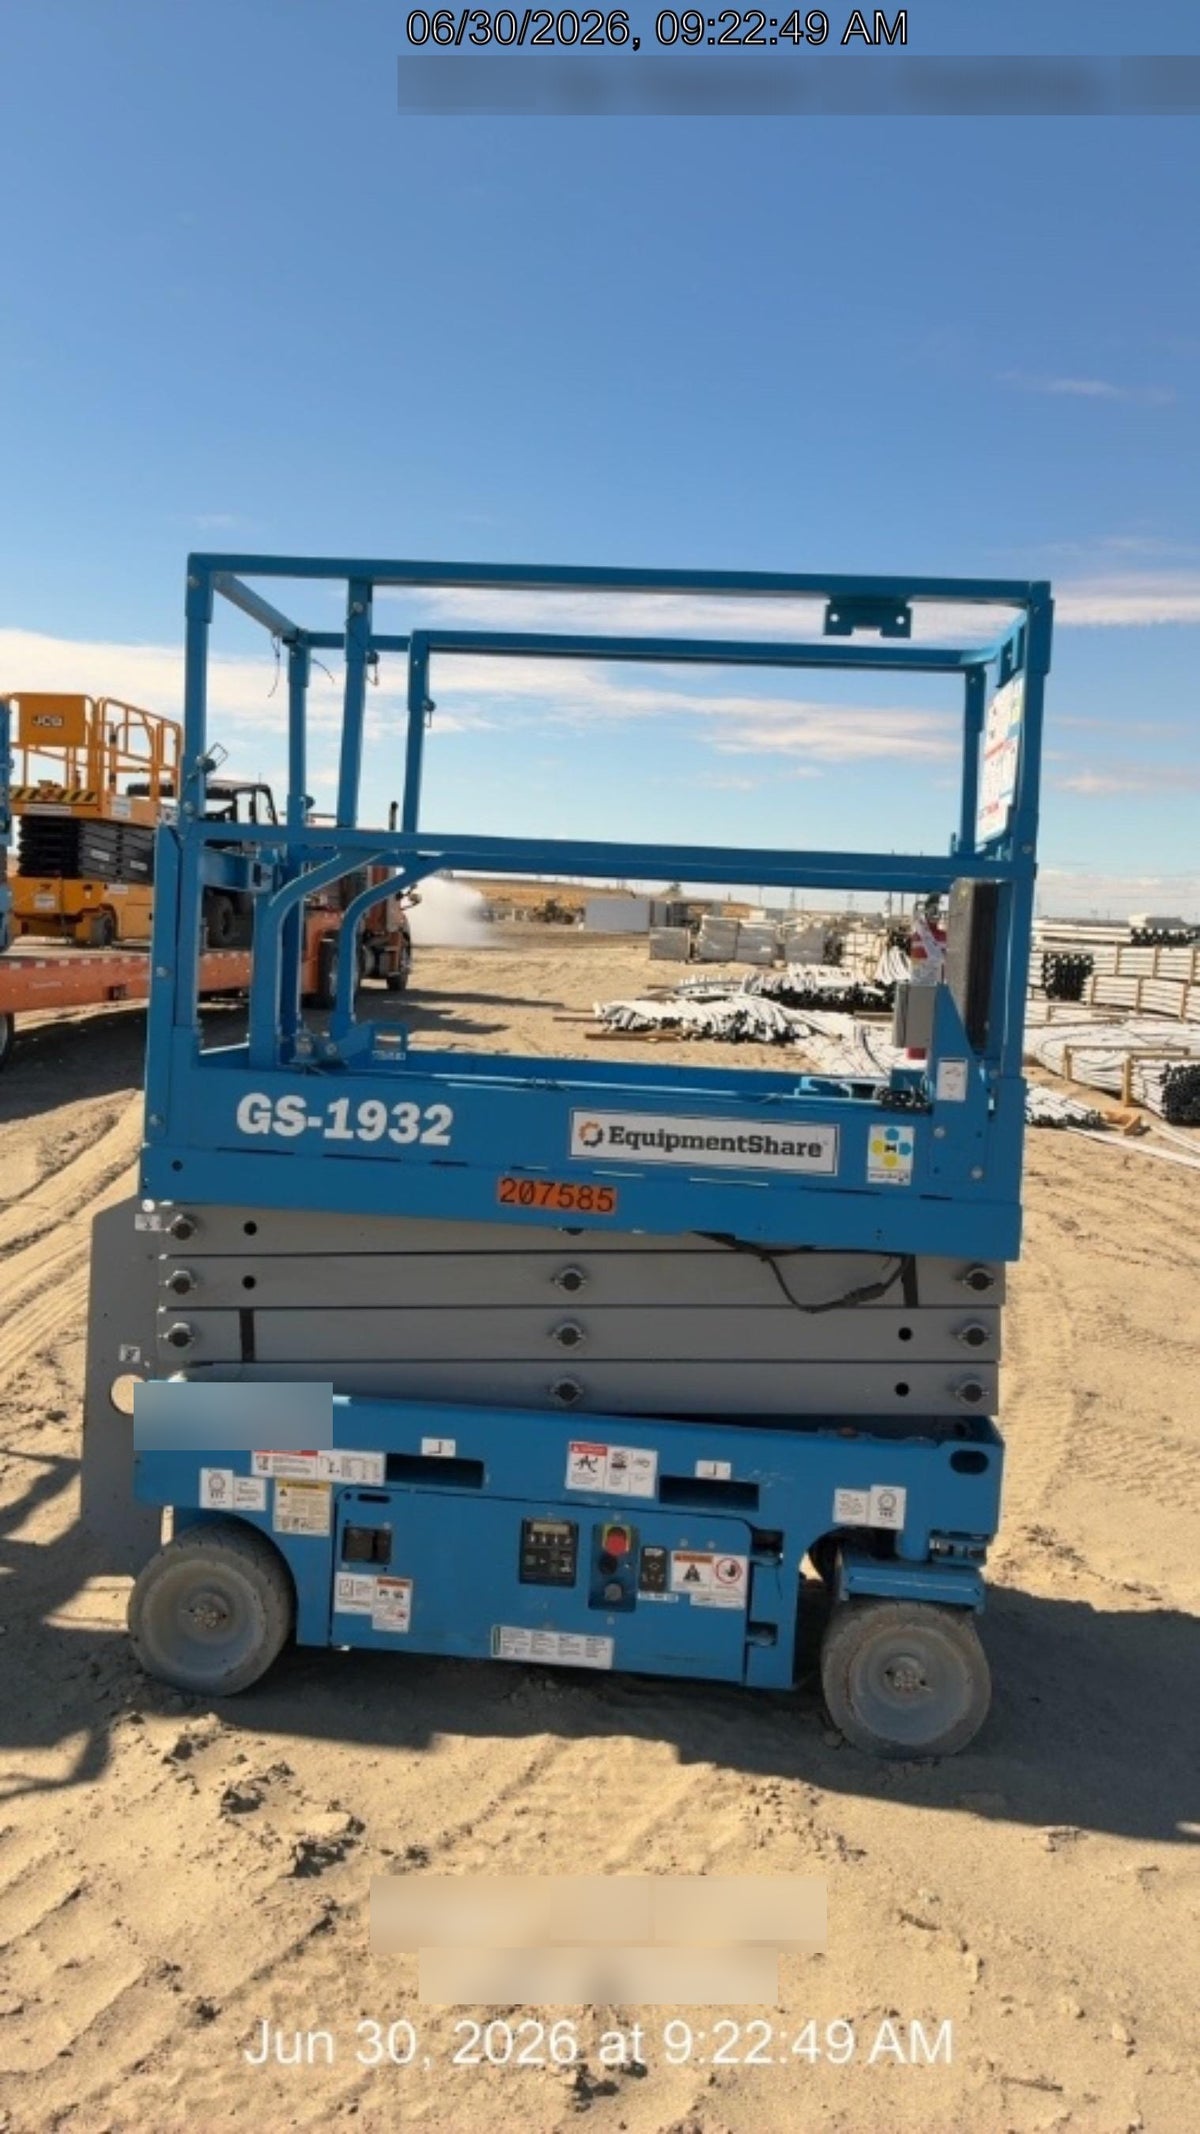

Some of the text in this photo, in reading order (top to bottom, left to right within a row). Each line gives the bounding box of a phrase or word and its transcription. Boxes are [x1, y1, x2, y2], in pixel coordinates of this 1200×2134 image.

[236, 1092, 453, 1146] GS-1932
[609, 1125, 823, 1159] EquipmentShare
[499, 1177, 615, 1213] 207585
